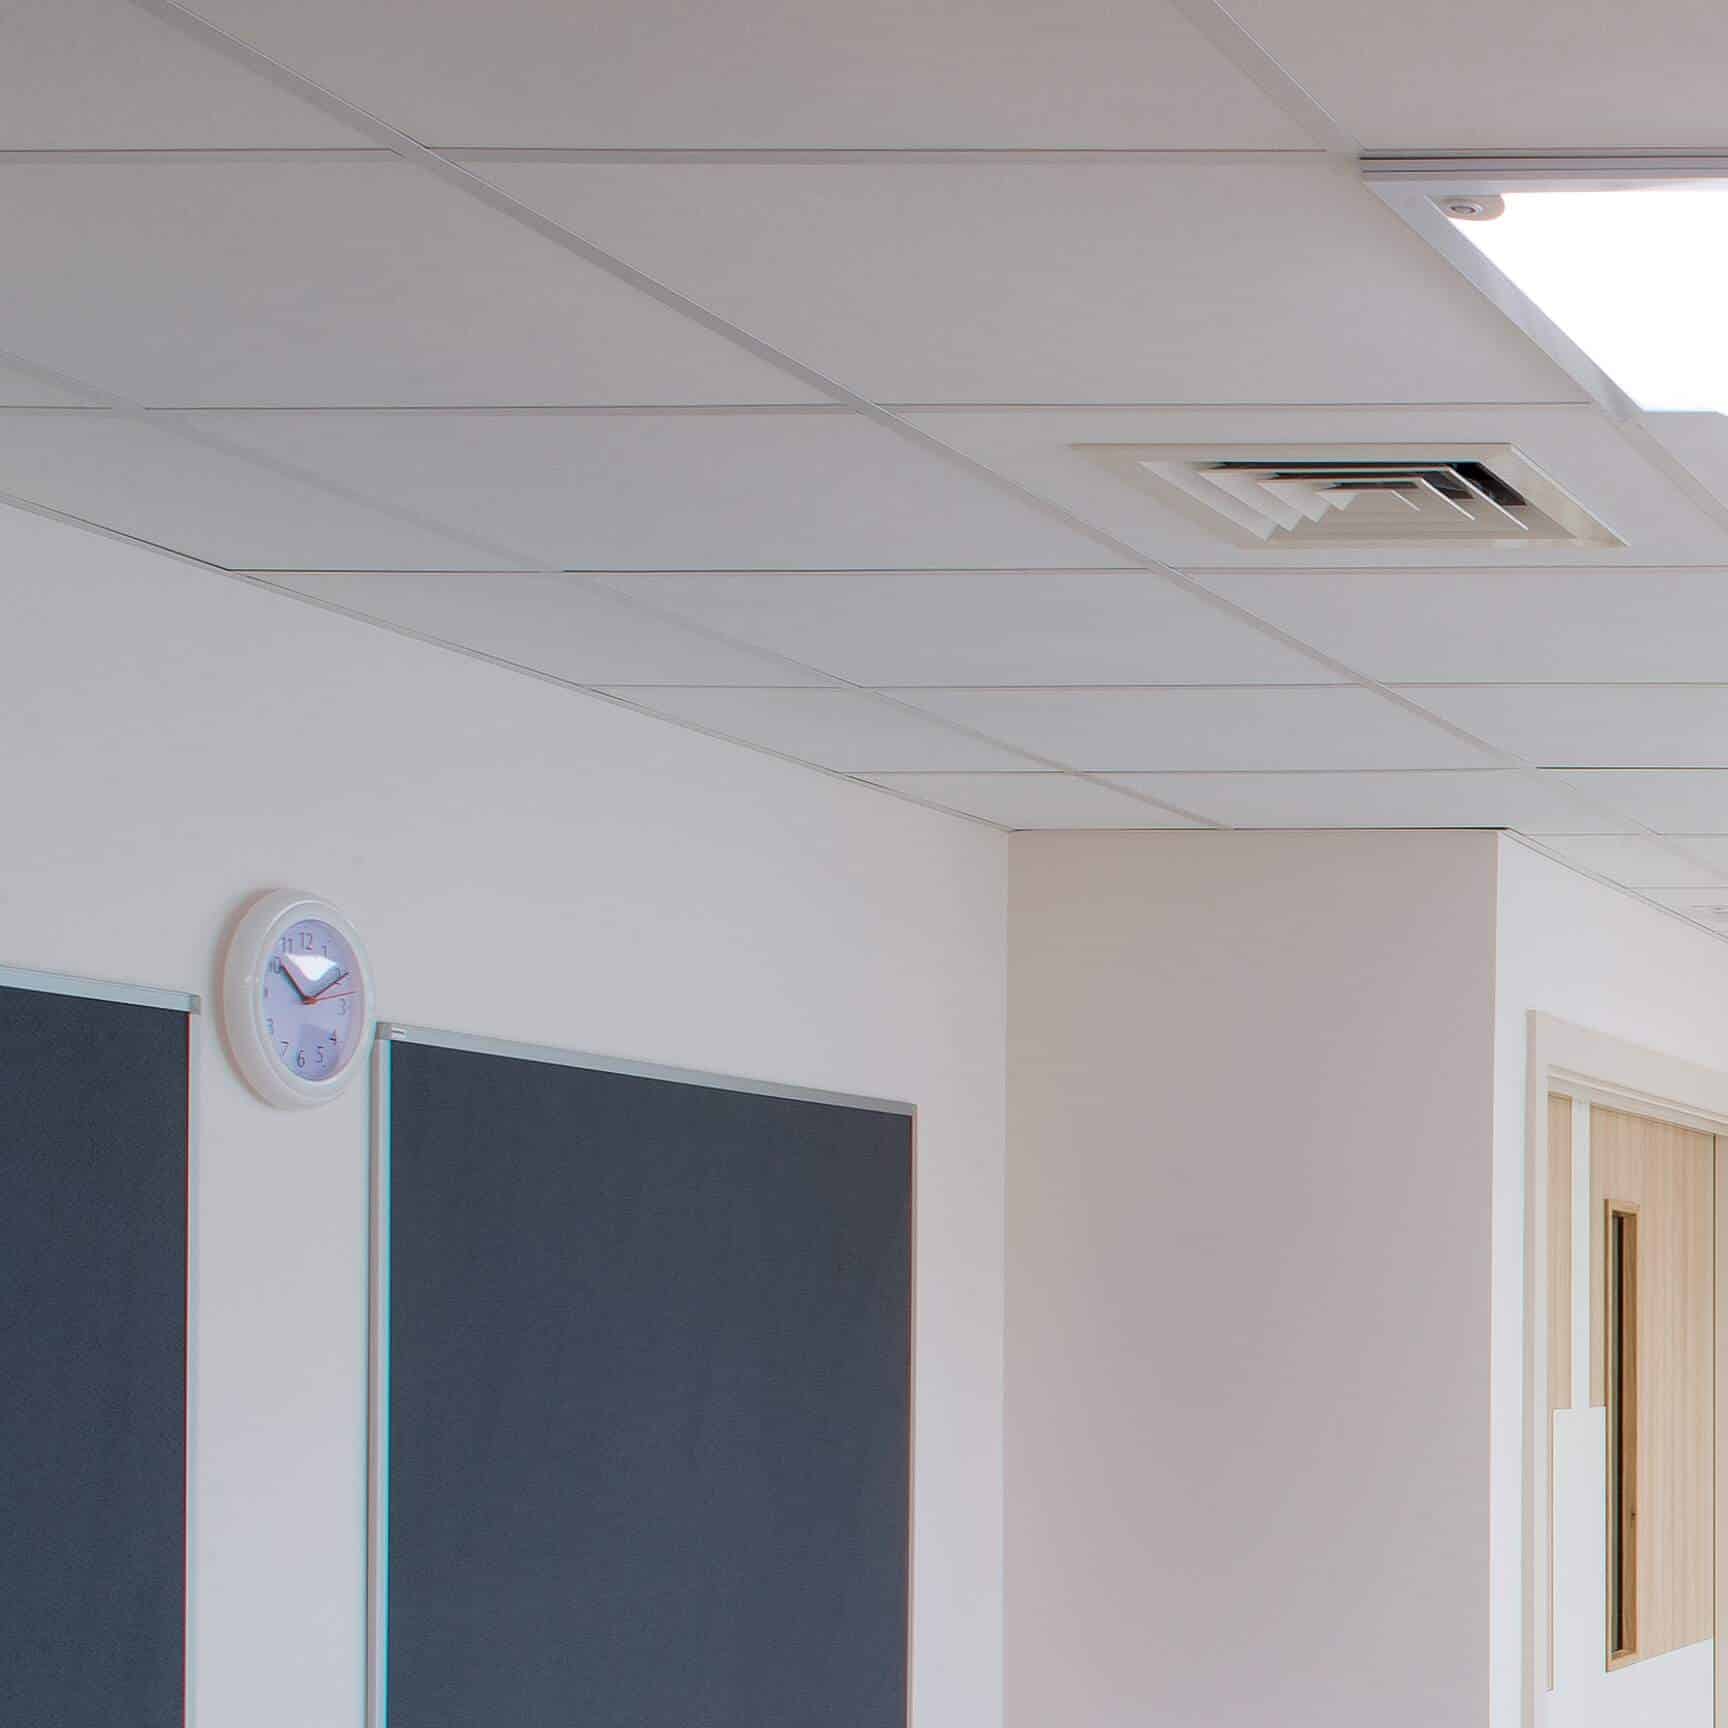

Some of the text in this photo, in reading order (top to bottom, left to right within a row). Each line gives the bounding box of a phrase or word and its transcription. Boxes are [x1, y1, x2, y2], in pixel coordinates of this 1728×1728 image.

[281, 937, 293, 953] 11
[298, 932, 313, 951] 12
[337, 998, 347, 1016] 3
[327, 1029, 338, 1045] 4
[280, 1040, 289, 1057] 7
[315, 1046, 324, 1063] 5
[296, 1049, 305, 1068] 6
